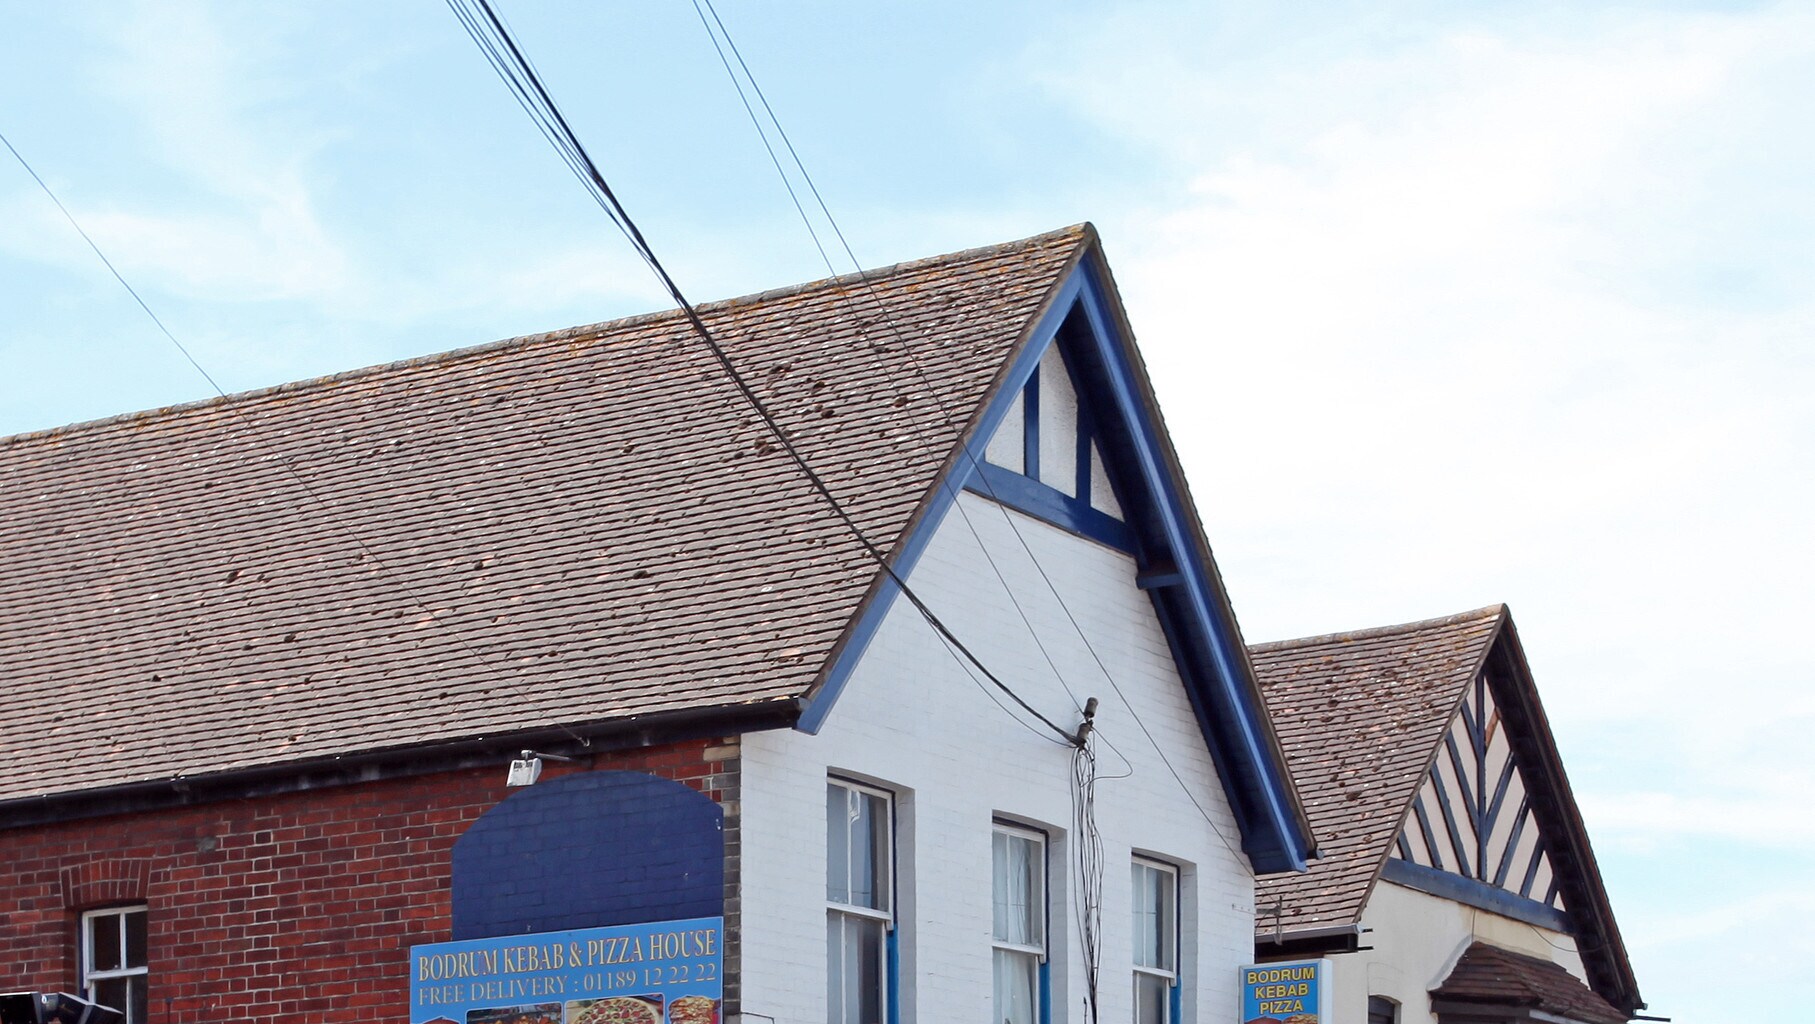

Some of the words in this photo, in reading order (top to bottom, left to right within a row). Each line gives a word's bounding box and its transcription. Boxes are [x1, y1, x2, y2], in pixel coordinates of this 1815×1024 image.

[418, 949, 498, 982] BODRUM
[504, 943, 564, 974] KEBAB
[569, 941, 583, 968] &
[587, 936, 644, 966] PIZZA
[650, 929, 716, 960] HOUSE
[1247, 967, 1315, 984] BODRUM
[419, 984, 465, 1006] FREE
[471, 975, 568, 1001] DELIVERY
[583, 970, 637, 991] 01189
[644, 968, 662, 986] 12
[669, 965, 689, 984] 22
[696, 963, 716, 982] 22
[1255, 983, 1309, 999] KEBAB
[1259, 999, 1303, 1015] PIZZA
